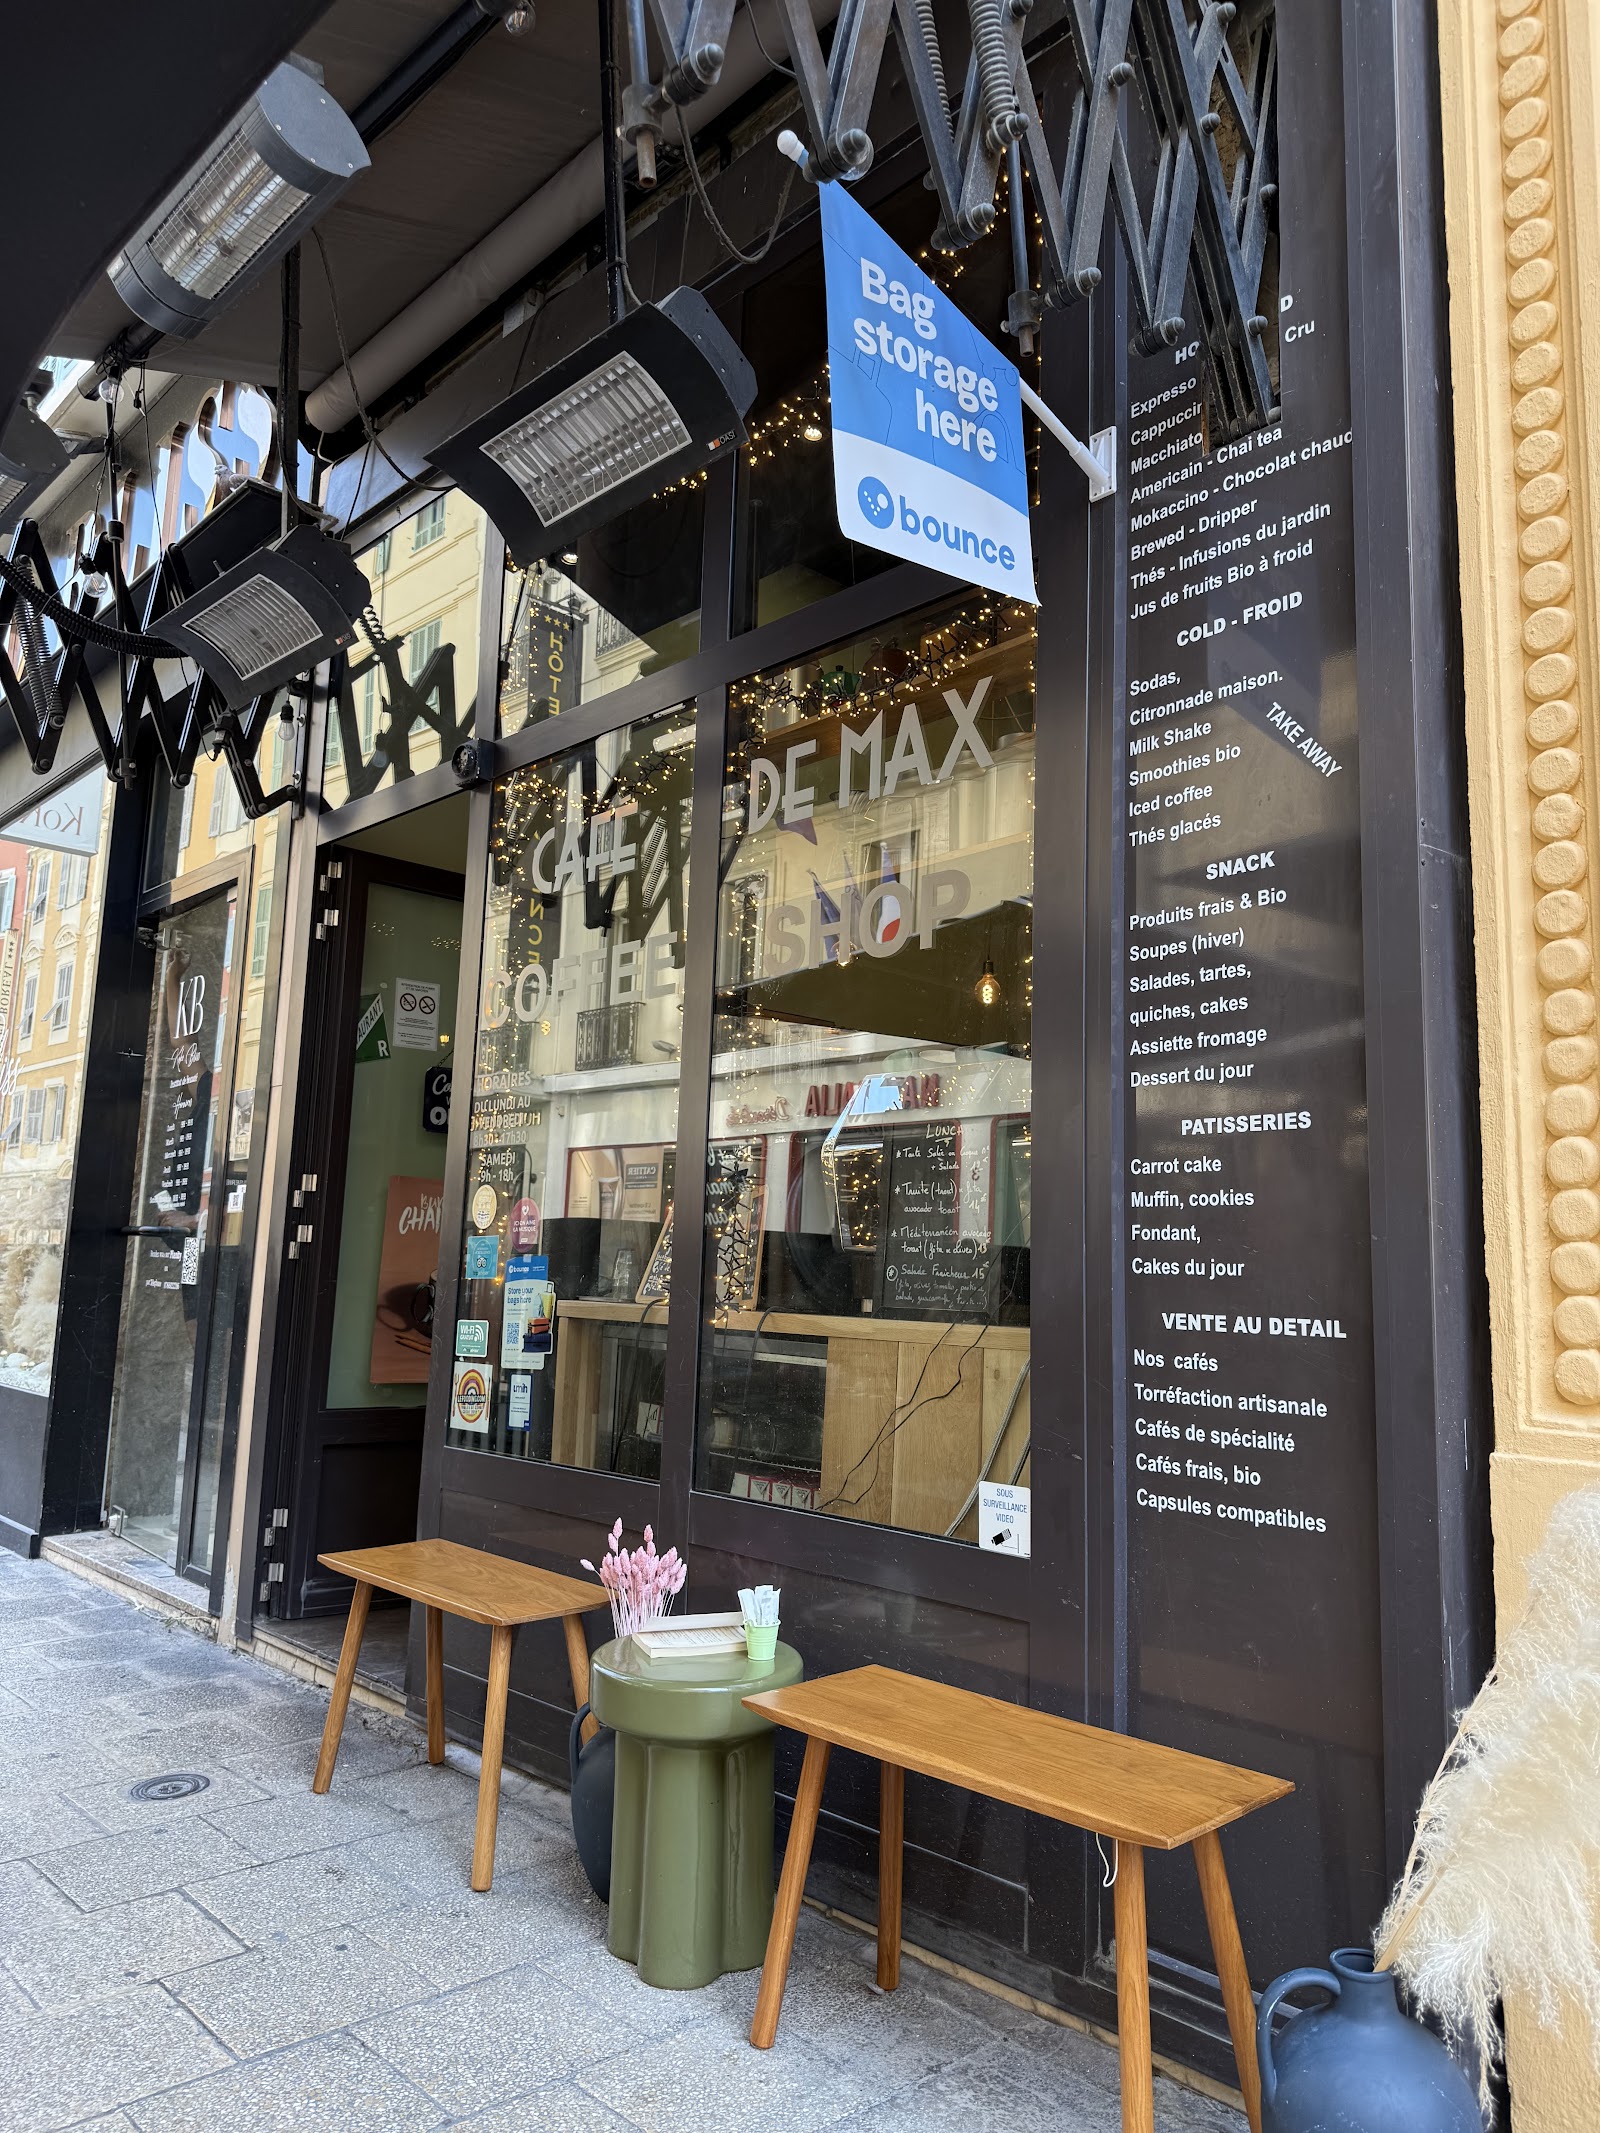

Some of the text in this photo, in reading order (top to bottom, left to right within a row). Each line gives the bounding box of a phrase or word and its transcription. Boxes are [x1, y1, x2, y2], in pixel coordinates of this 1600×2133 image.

[859, 256, 937, 340] Bag
[1285, 320, 1314, 342] Cru
[853, 316, 999, 413] storage
[1131, 378, 1196, 418] Expresso
[915, 388, 997, 462] here
[1131, 432, 1203, 475] Macchiato
[1131, 462, 1202, 504] Americain
[1217, 435, 1252, 463] Chai
[1257, 428, 1282, 447] tea
[1131, 490, 1209, 533] Mokaccino
[1223, 450, 1296, 491] Chocolat
[899, 494, 1016, 570] bounce
[1131, 525, 1184, 561] Brewed
[1199, 499, 1257, 532] Dripper
[1131, 567, 1165, 589] Thés
[1179, 534, 1251, 571] Infusions
[1256, 524, 1276, 541] du
[1281, 504, 1330, 536] jardin
[1131, 539, 1312, 619] Jus de fruits Bio à froid
[1177, 618, 1226, 646] COLD
[1243, 592, 1302, 624] FROID
[1130, 672, 1180, 696] Sodas,
[1130, 671, 1283, 725] Citronnade maison.
[1130, 723, 1211, 756] Milk Shake
[1266, 702, 1342, 777] TAKE AWAY
[1129, 744, 1240, 786] Smoothies bio
[532, 675, 995, 894] CAFÉ DE MAX
[1130, 786, 1212, 816] Iced coffee
[1129, 813, 1221, 846] Thés glacés
[1206, 851, 1275, 880] SNACK
[1130, 888, 1286, 930] Produits frais & Bio
[484, 869, 972, 1029] COFFEE SHOP
[1130, 927, 1244, 961] Soupes (hiver)
[1130, 964, 1251, 992] Salades, tartes,
[173, 974, 205, 1039] KB
[1130, 997, 1248, 1027] quiches, cakes
[378, 1040, 389, 1057] R
[1130, 1029, 1267, 1055] Assiette fromage
[477, 1071, 531, 1091] HORAIRES
[1131, 1063, 1254, 1087] Dessert du jour
[517, 1095, 531, 1108] AU
[926, 1124, 964, 1138] LUNCH
[1182, 1111, 1311, 1135] PATISSERIES
[481, 1151, 516, 1166] SAMEDI
[1131, 1156, 1221, 1174] Carrot cake
[480, 1170, 491, 1182] 9h
[498, 1168, 514, 1181] 18h
[1131, 1189, 1254, 1209] Muffin, cookies
[1132, 1224, 1200, 1244] Fondant,
[1132, 1258, 1245, 1280] Cakes du jour
[1162, 1313, 1346, 1338] VENTE AU DETAIL
[1134, 1349, 1218, 1371] Nos cafés
[1134, 1383, 1327, 1417] Torréfaction artisanale
[1135, 1418, 1295, 1452] Cafés de spécialité
[1136, 1453, 1261, 1485] Cafés frais, bio
[983, 1498, 1028, 1513] SURVEILLANCE
[997, 1488, 1013, 1498] SOUS
[996, 1513, 1014, 1523] VIDEO
[1137, 1488, 1326, 1532] Capsules compatibles
